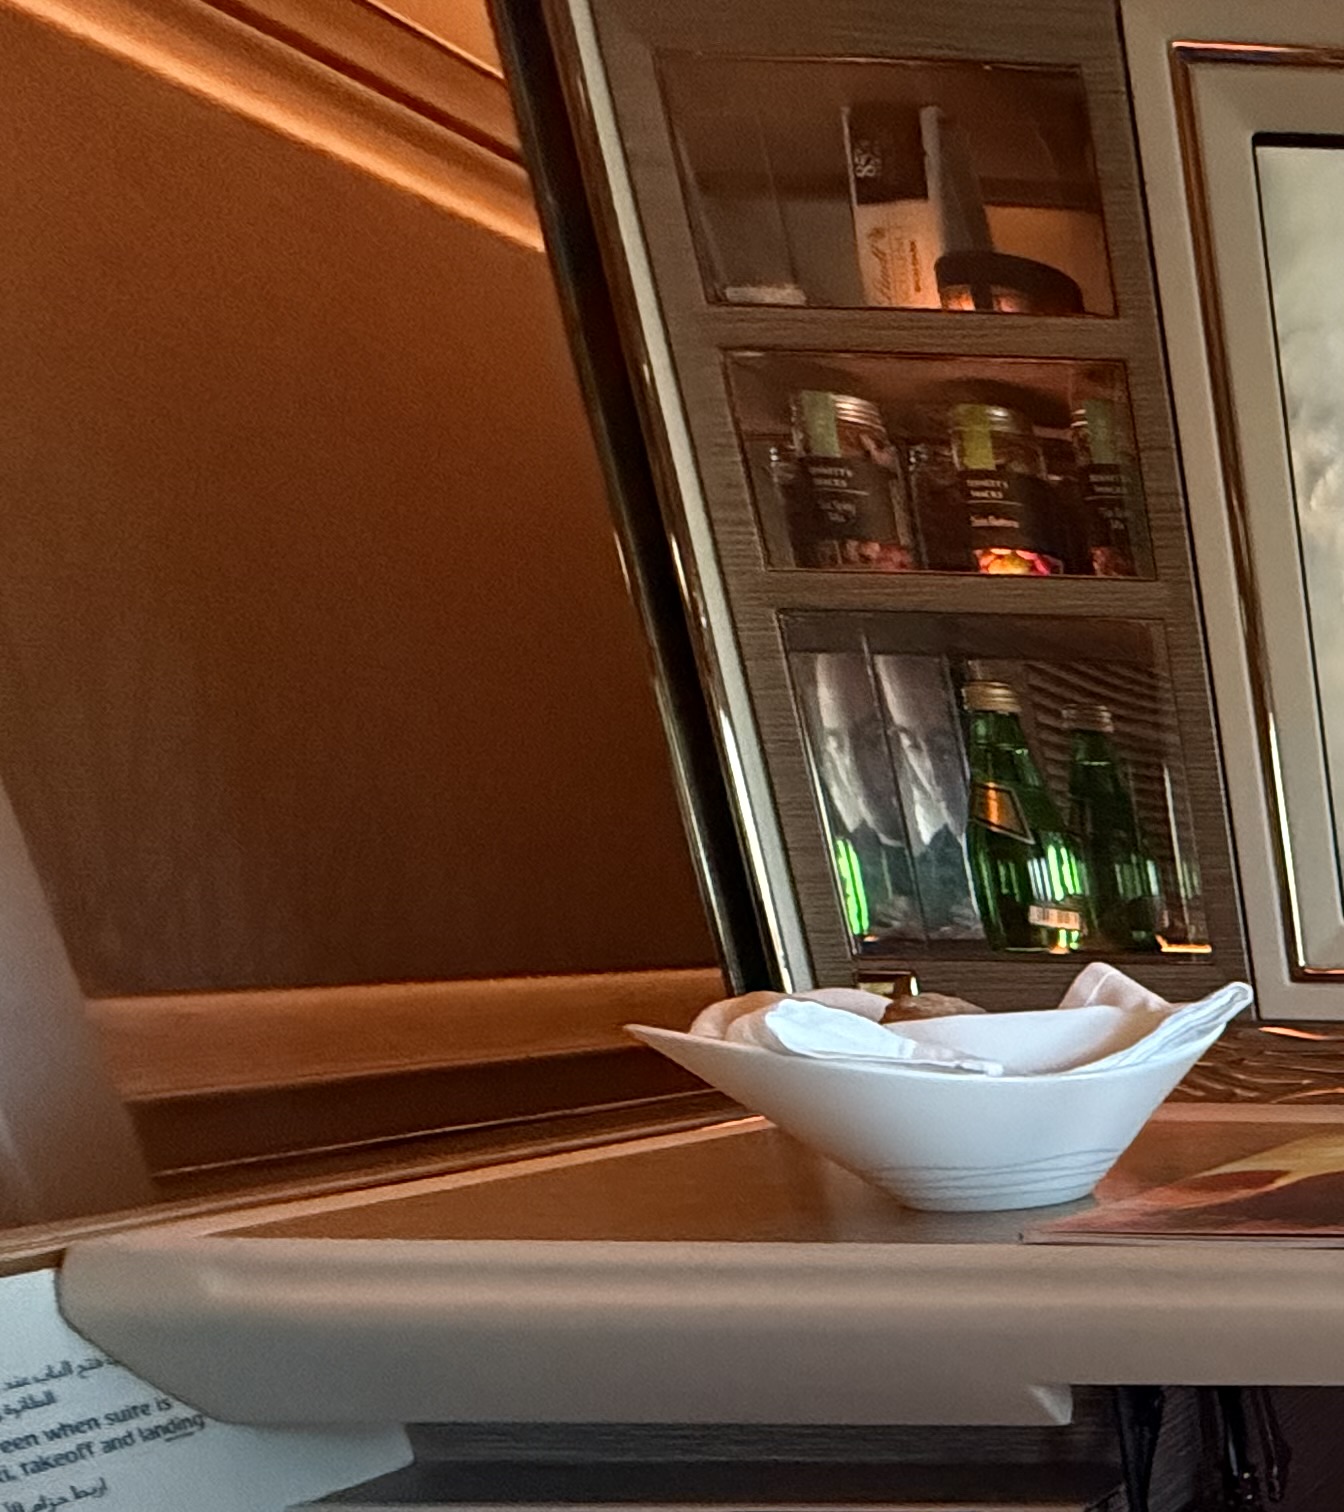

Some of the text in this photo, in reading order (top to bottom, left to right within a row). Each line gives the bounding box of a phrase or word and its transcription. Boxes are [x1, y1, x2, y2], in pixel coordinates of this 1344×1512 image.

[20, 1441, 95, 1476] takeoff
[101, 1430, 136, 1454] and
[138, 1413, 206, 1442] landing
[43, 1417, 101, 1442] when
[104, 1403, 151, 1426] suite
[155, 1397, 172, 1412] is
